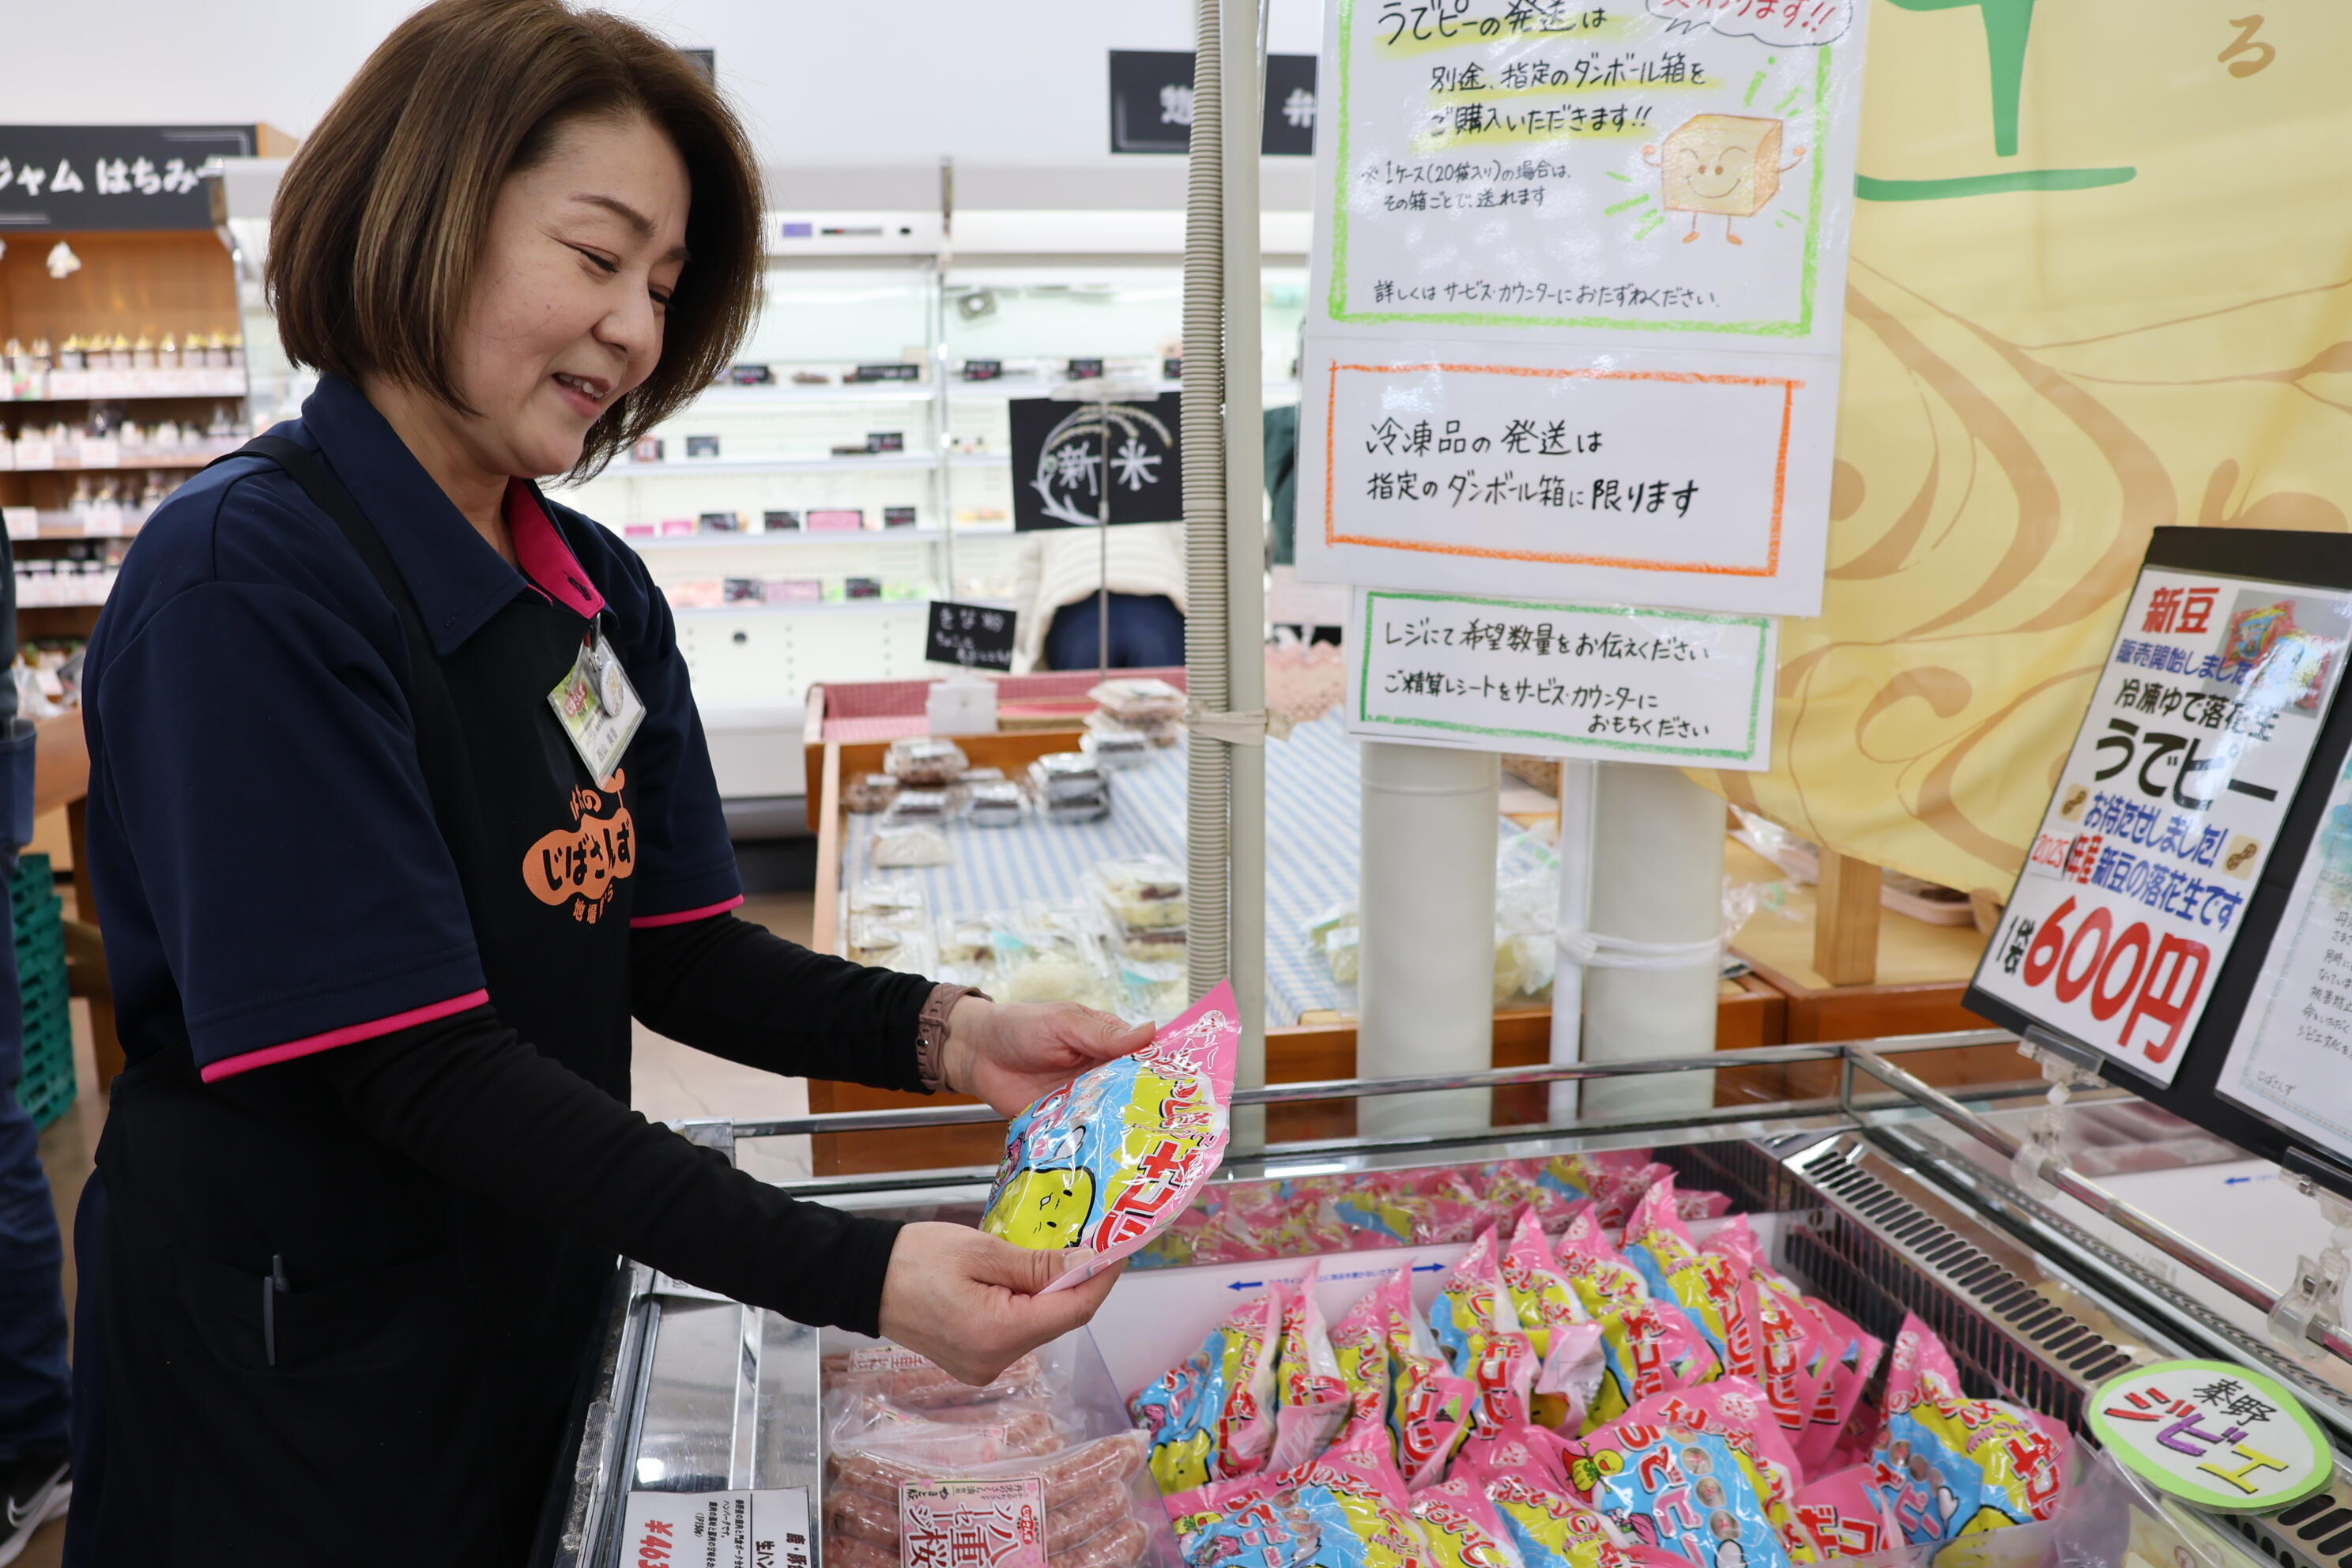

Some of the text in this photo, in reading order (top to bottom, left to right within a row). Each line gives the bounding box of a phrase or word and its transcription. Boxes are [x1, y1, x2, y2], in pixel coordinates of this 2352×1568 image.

[2218, 14, 2276, 78] る
[1366, 417, 1604, 457] 冷凍品の発送は
[1057, 439, 1163, 496] 新米
[1366, 472, 1699, 518] 指定のダンボール箱に限ります
[2141, 586, 2221, 634] 新豆
[1385, 618, 1710, 662] レジにて希望数量をお伝えください
[1587, 714, 1710, 739] おもちください
[2115, 677, 2280, 743] 冷凍ゆで落花生
[2094, 717, 2278, 812] うでピー
[2022, 895, 2211, 1065] 600円
[2193, 1378, 2278, 1427] 秦野
[2103, 1387, 2290, 1494] ジビエ
[909, 1503, 1015, 1530] ソーセージ
